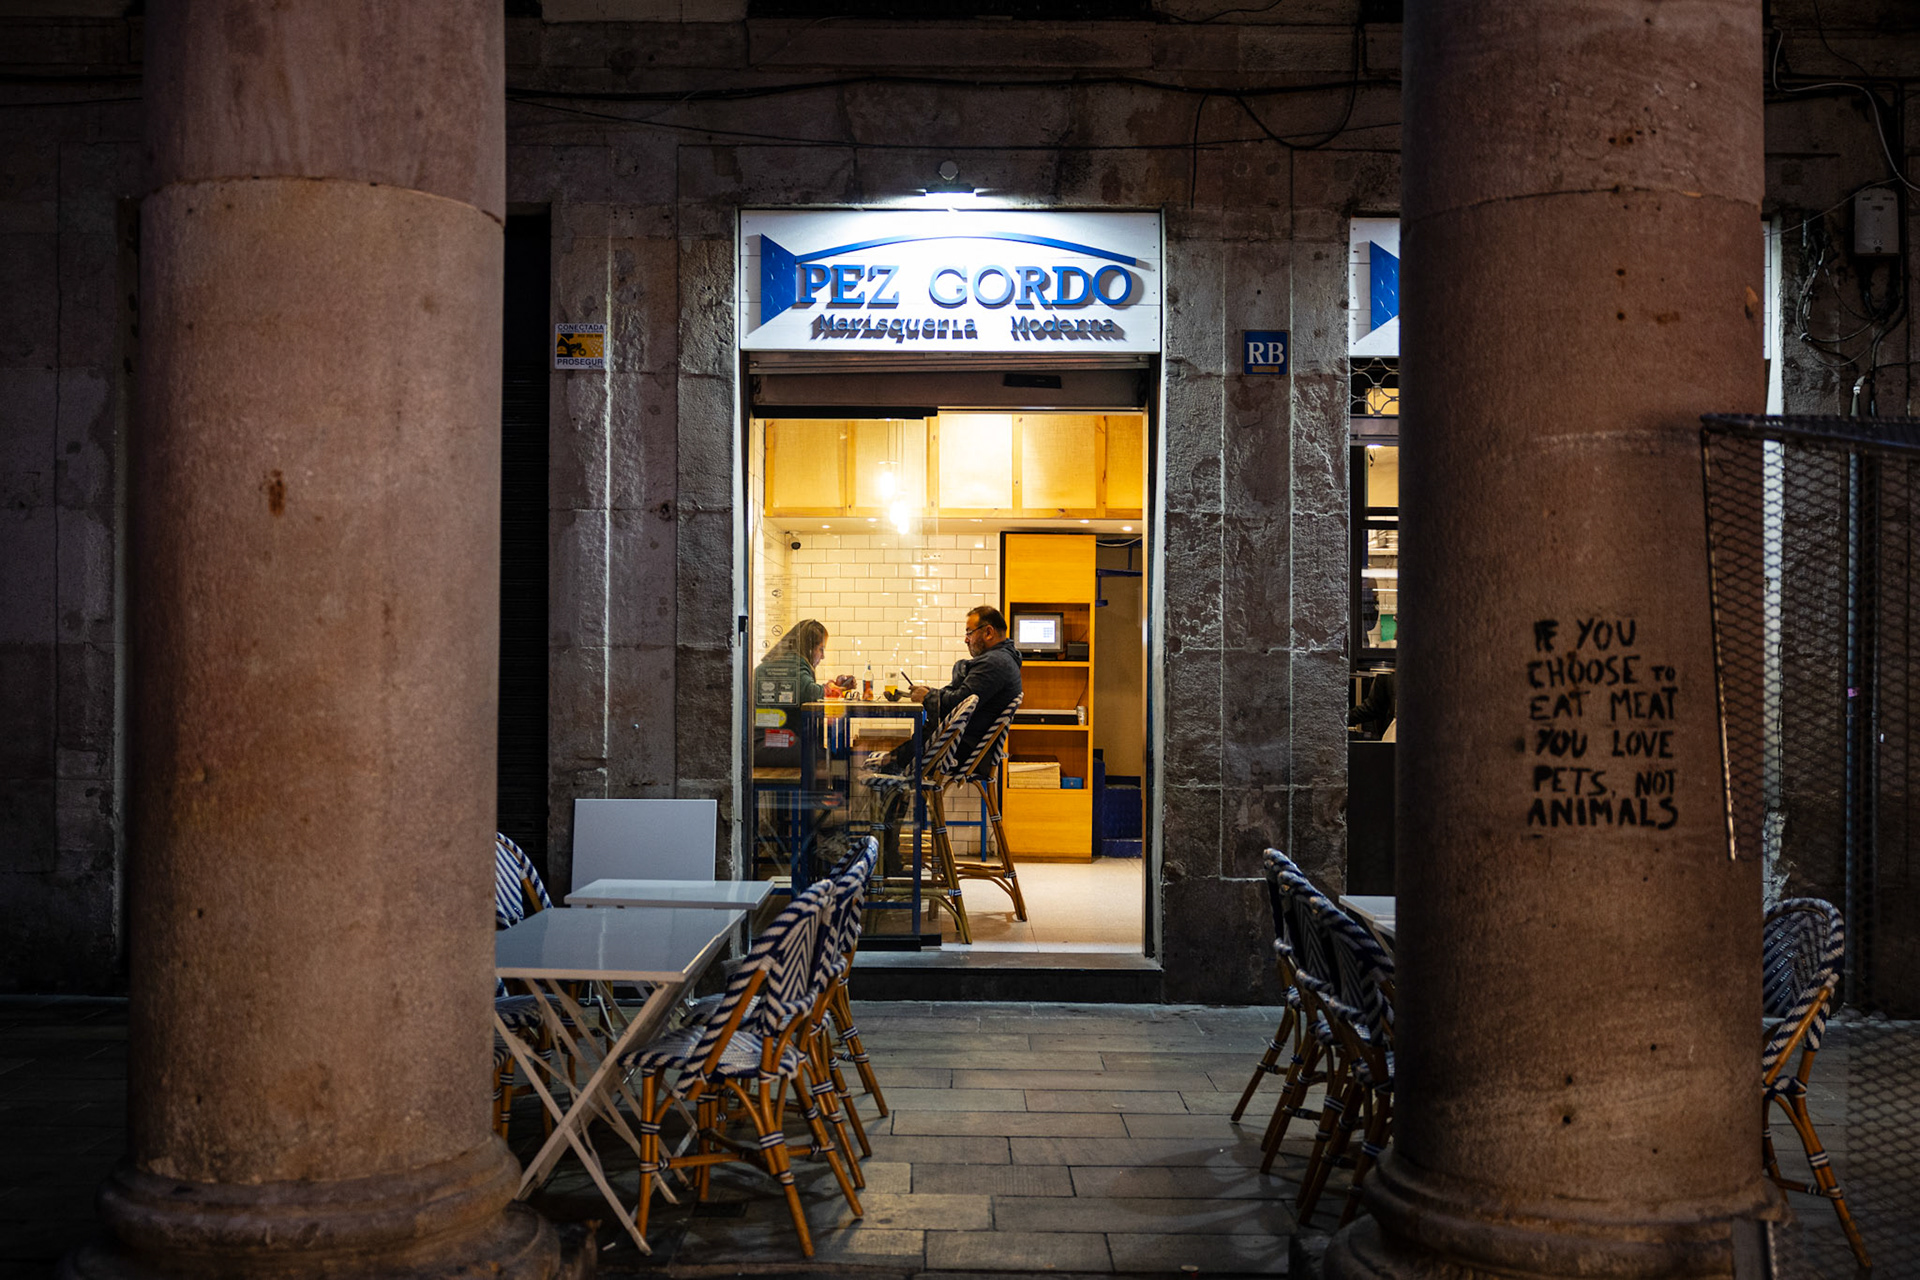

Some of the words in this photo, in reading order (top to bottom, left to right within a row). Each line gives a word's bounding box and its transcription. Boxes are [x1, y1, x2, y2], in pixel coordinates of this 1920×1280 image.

[799, 264, 899, 307] PEZ
[929, 264, 1133, 307] GORDO
[1011, 314, 1120, 339] Moderna
[1247, 342, 1285, 365] RB
[1534, 619, 1559, 651] IF
[1577, 618, 1636, 651] YOU
[1527, 655, 1640, 688] CHOOSE
[1651, 665, 1676, 682] TO
[1530, 690, 1591, 720] EAT
[1609, 686, 1678, 721] MEAT
[1535, 729, 1588, 758] YOU
[1612, 730, 1674, 758] LOVE
[1534, 765, 1617, 798] PETS,
[1635, 769, 1677, 797] NOT
[1527, 797, 1679, 829] ANIMALS
